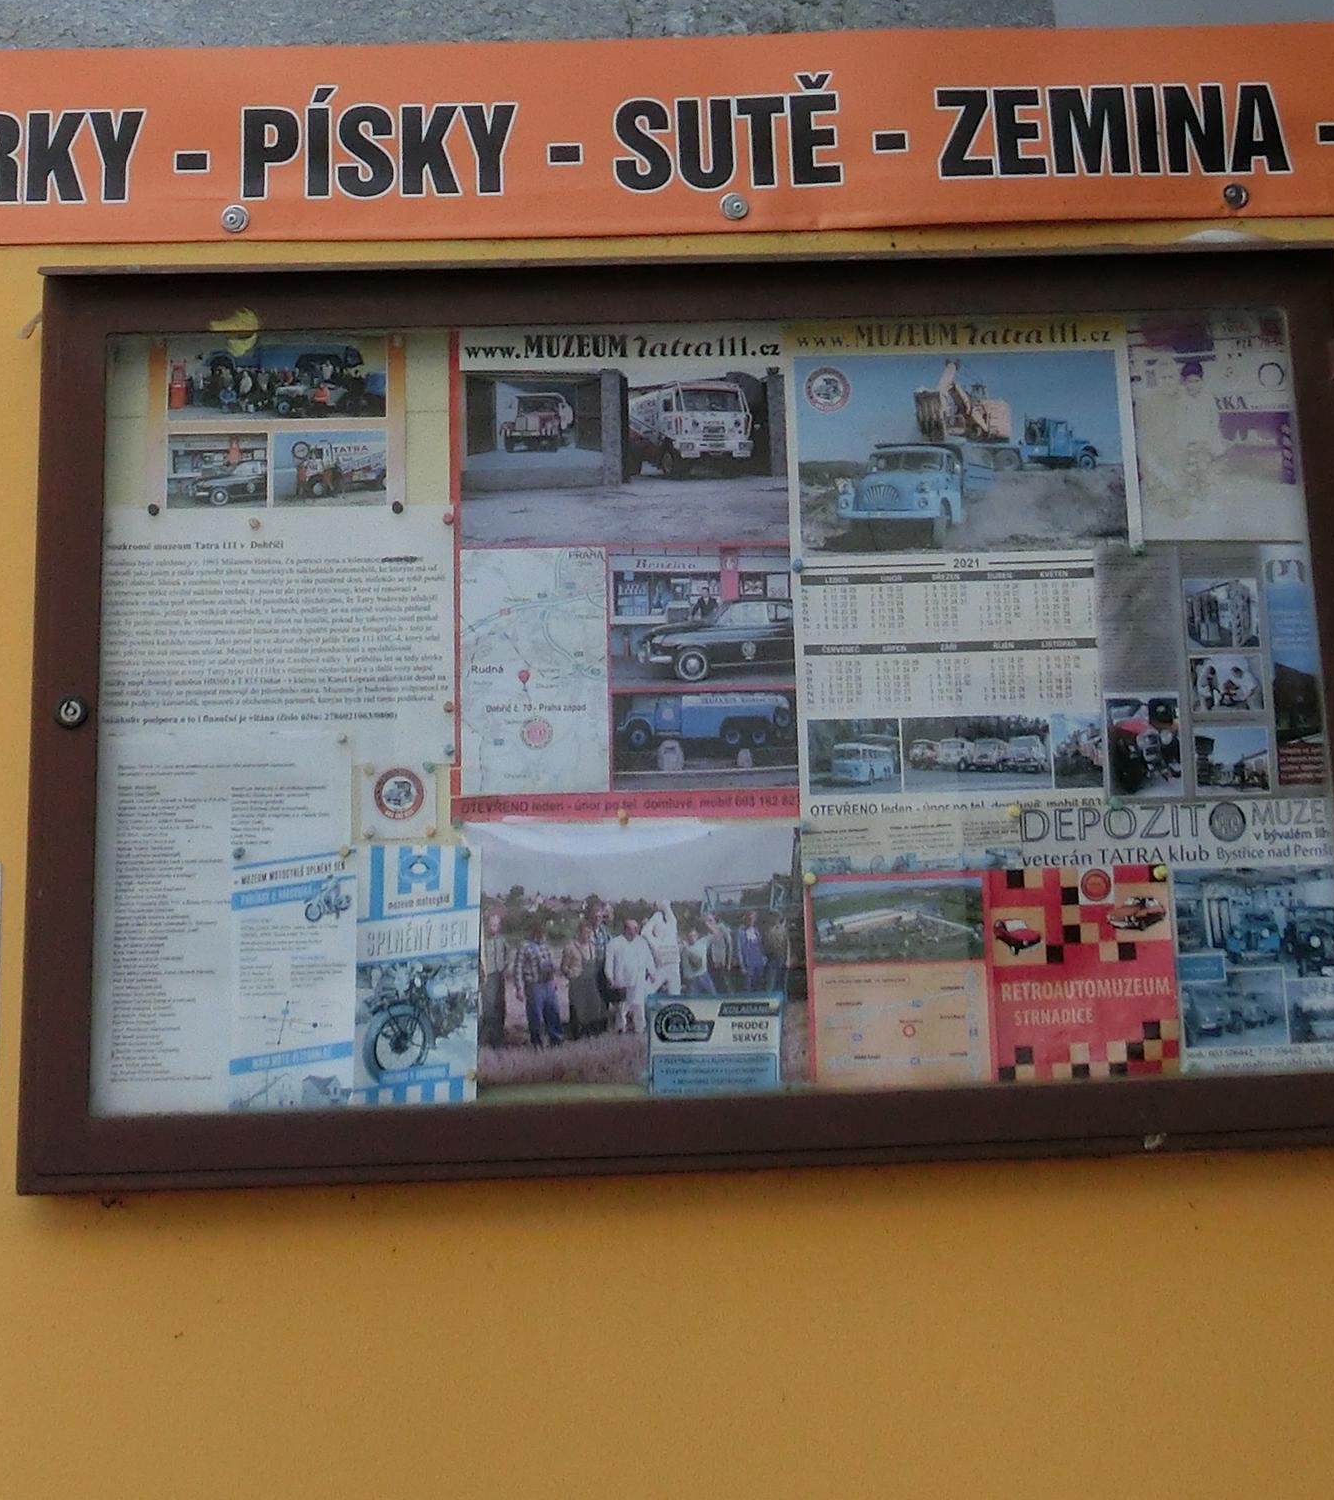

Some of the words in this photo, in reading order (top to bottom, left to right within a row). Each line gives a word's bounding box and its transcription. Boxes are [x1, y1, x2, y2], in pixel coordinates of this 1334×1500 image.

[240, 84, 519, 200] PÍSKY
[612, 71, 845, 194] SUTĚ
[933, 82, 1294, 180] ZEMINA
[953, 558, 980, 568] 2021
[471, 665, 504, 674] Rudná
[810, 801, 878, 817] OTEVŘENO
[1018, 804, 1206, 842] DEPOZIT
[1021, 849, 1092, 867] veterán
[1097, 847, 1164, 866] TATRA
[1168, 844, 1209, 862] klub
[1001, 977, 1171, 1002] RETROAUTOMUZEUM
[731, 1020, 770, 1031] PRODEJ
[1014, 1008, 1094, 1027] STRNADICE
[732, 1032, 770, 1043] SERVIS
